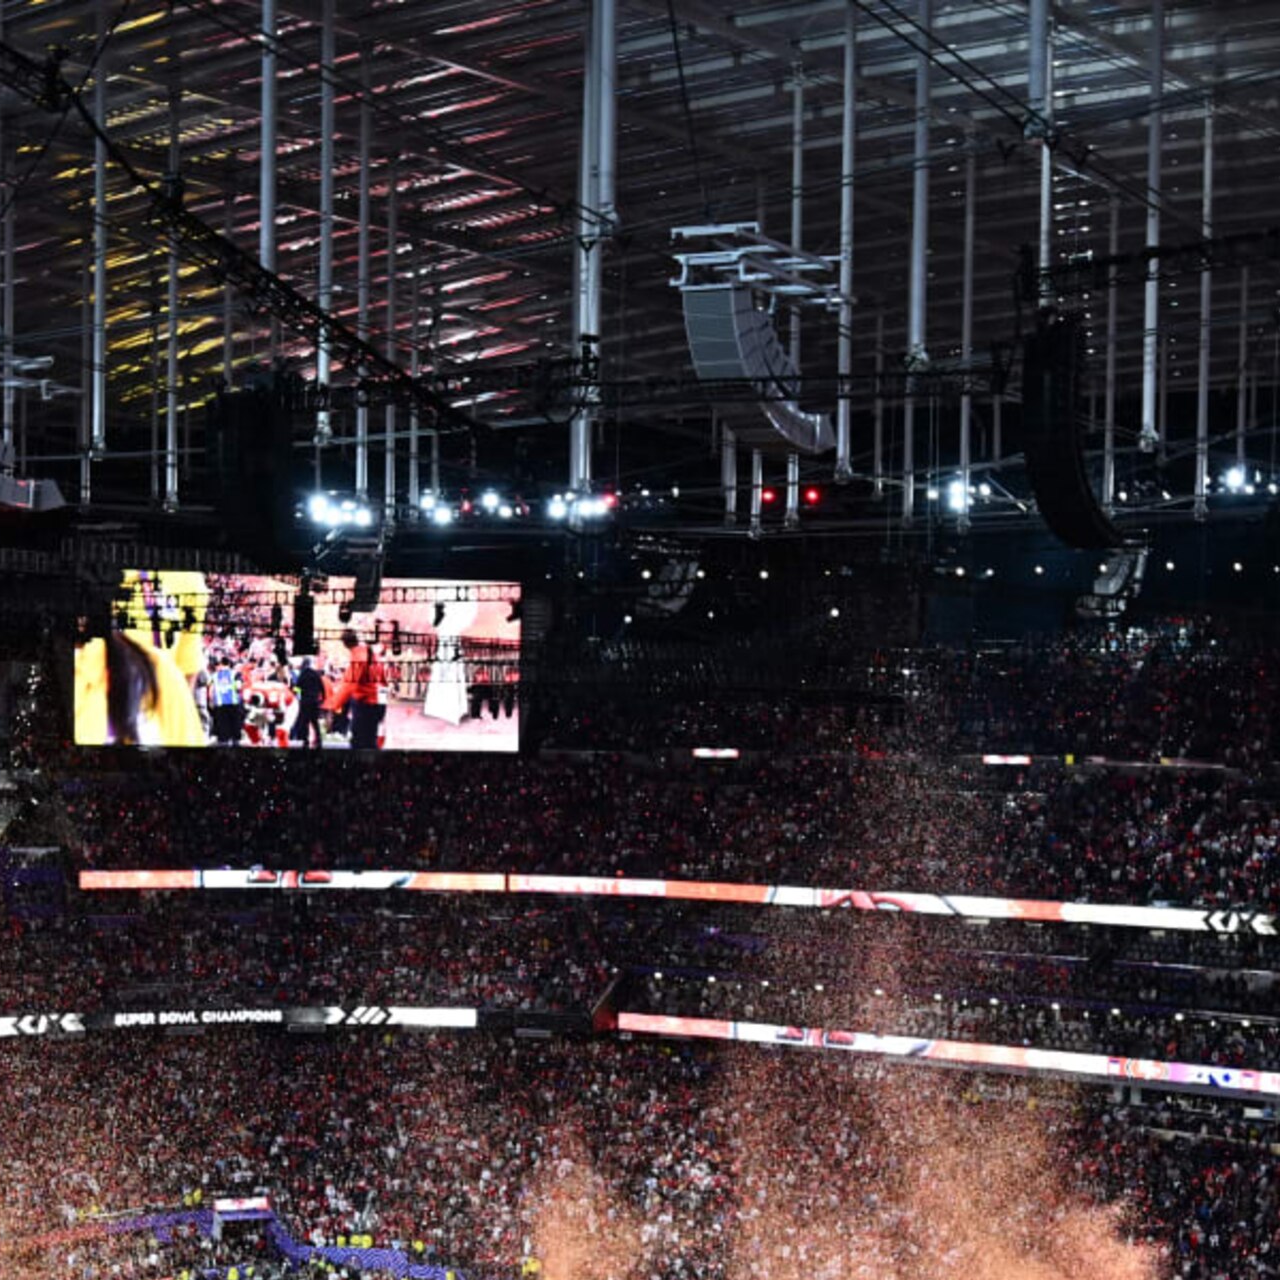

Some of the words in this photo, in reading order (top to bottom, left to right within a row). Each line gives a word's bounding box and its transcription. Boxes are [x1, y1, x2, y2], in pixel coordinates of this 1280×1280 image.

[114, 1011, 155, 1027] SUPER
[159, 1010, 198, 1025] BOWL
[202, 1009, 283, 1024] CHAMPIONS
